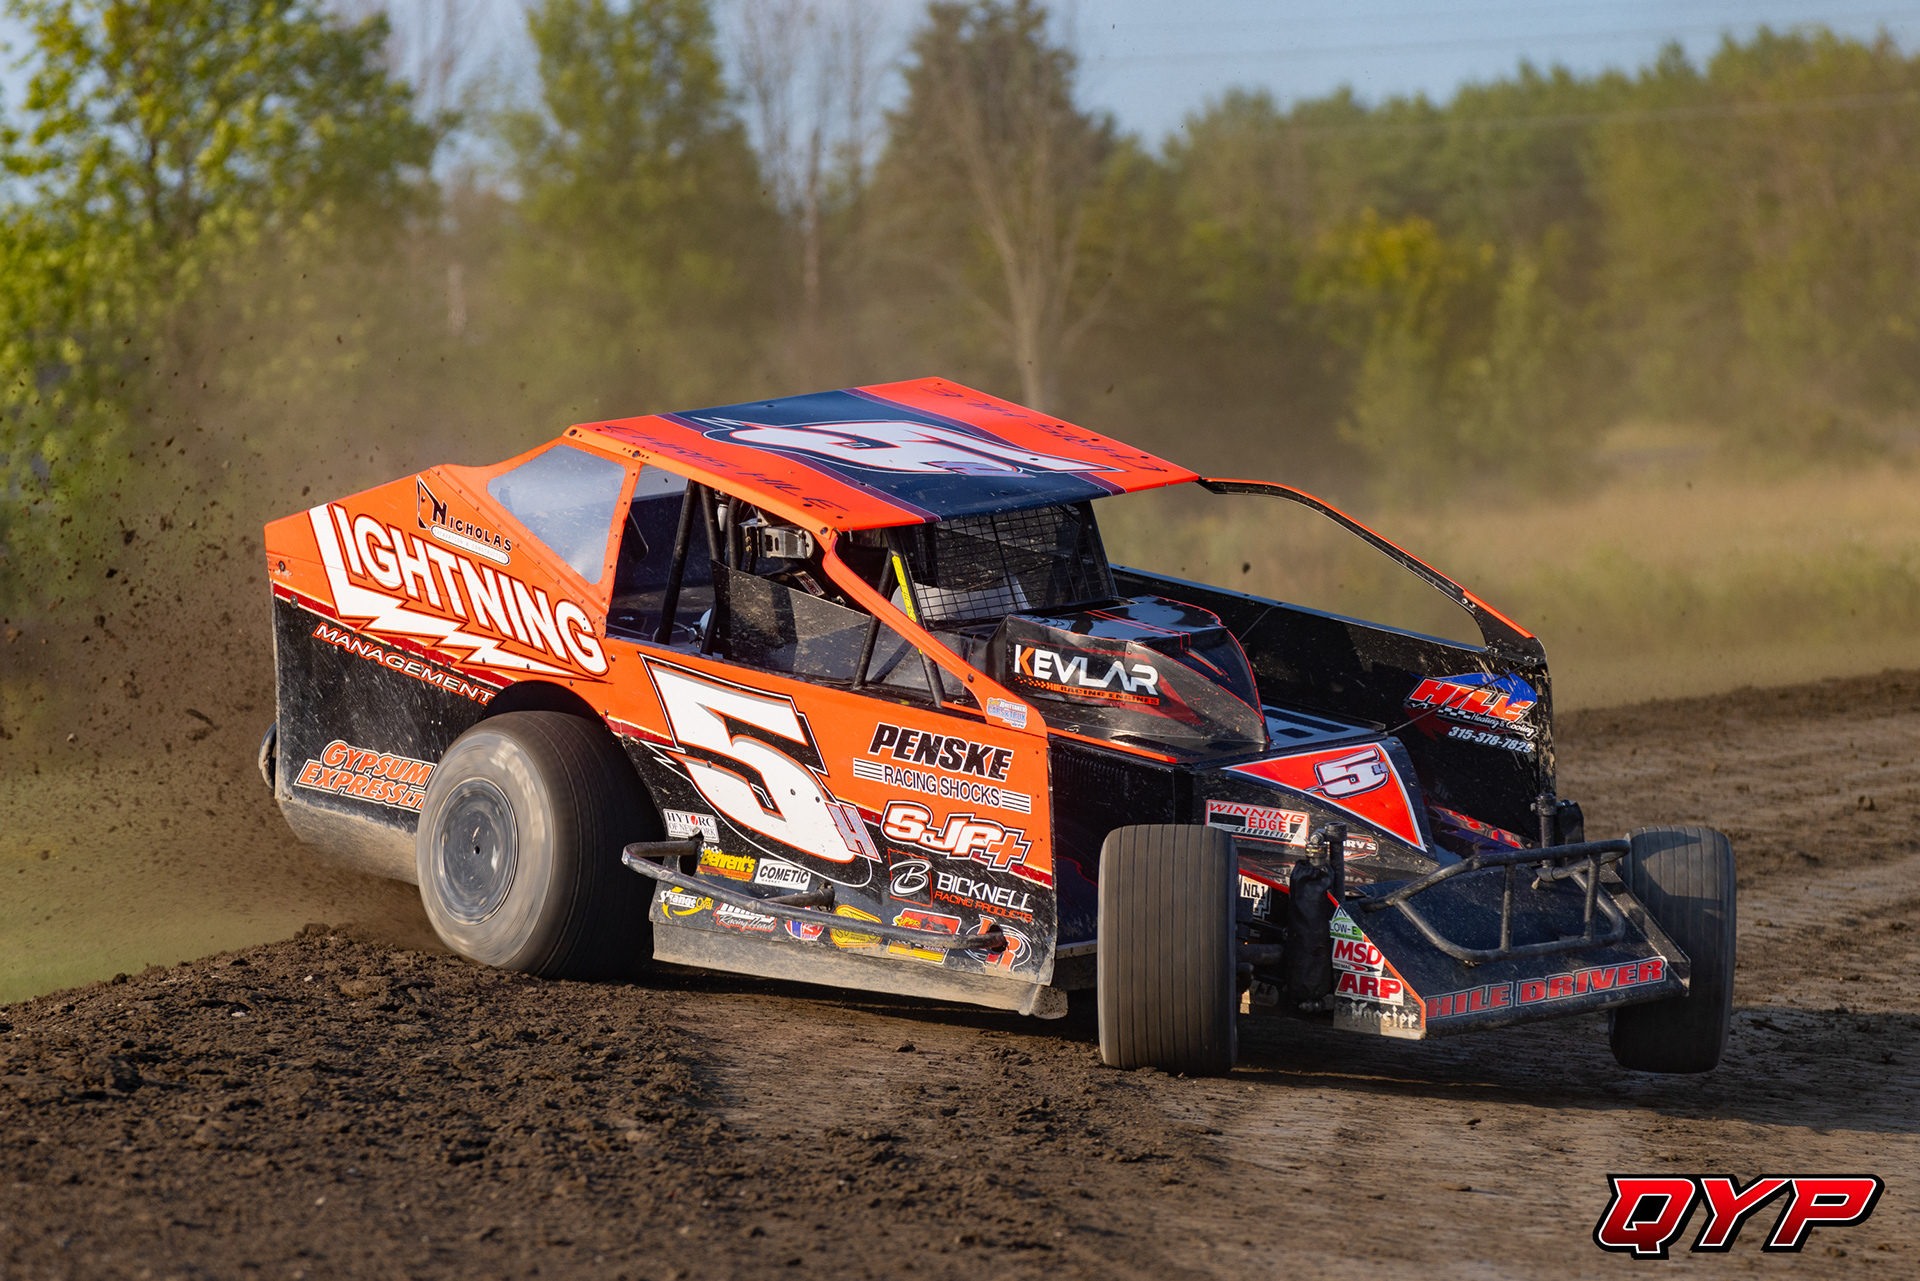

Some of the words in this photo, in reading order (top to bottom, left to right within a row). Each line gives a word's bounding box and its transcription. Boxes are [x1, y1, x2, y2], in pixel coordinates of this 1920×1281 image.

[604, 425, 741, 468] CHRIS
[736, 472, 850, 512] HILE
[430, 499, 512, 552] NICHOLAS
[309, 503, 611, 677] LIGHTNING
[313, 623, 497, 705] MANAGEMENT
[1013, 643, 1159, 696] KEVLAR
[1060, 686, 1106, 698] RACING
[1108, 691, 1159, 705] ENGINES
[1408, 679, 1534, 722] HILE
[1471, 713, 1499, 729] Heating
[1506, 721, 1535, 737] Cooling
[323, 742, 433, 786] GYPSUM
[868, 722, 1013, 781] PENSKE
[299, 762, 408, 804] EXPRESS
[883, 765, 937, 794] RACING
[940, 777, 1000, 807] SHOCKS
[668, 822, 678, 830] OF
[701, 827, 716, 836] ORK
[1209, 803, 1305, 823] WINNING
[1248, 817, 1287, 832] EDGE
[700, 849, 756, 873] Behrent's
[759, 865, 809, 884] COMETIC
[658, 890, 697, 909] Strange
[696, 897, 713, 910] Oval
[934, 890, 973, 908] RACING
[974, 899, 1033, 923] PRODUCTS
[937, 871, 1034, 913] BICKNELL
[719, 914, 749, 930] Racing
[747, 917, 775, 931] Heads
[894, 916, 921, 927] SUPER
[1334, 939, 1383, 965] MSD
[1338, 972, 1402, 999] ARP
[1426, 986, 1511, 1018] HILE
[1520, 959, 1664, 1003] DRIVER
